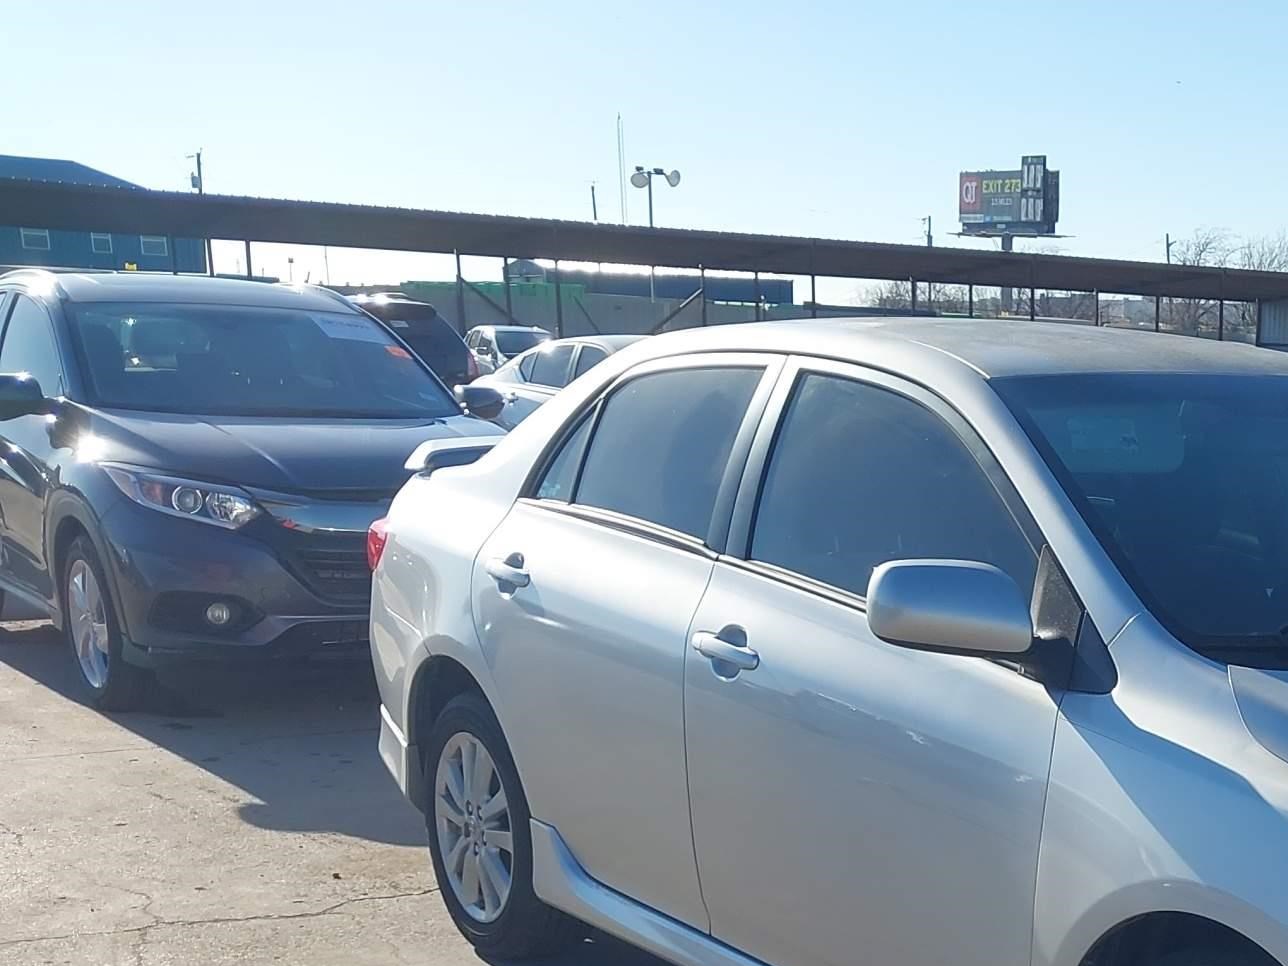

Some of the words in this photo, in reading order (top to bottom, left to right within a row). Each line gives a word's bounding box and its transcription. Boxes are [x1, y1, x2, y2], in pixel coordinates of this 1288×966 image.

[963, 182, 977, 203] QT
[982, 179, 1003, 193] EXIT
[1004, 179, 1021, 193] 273
